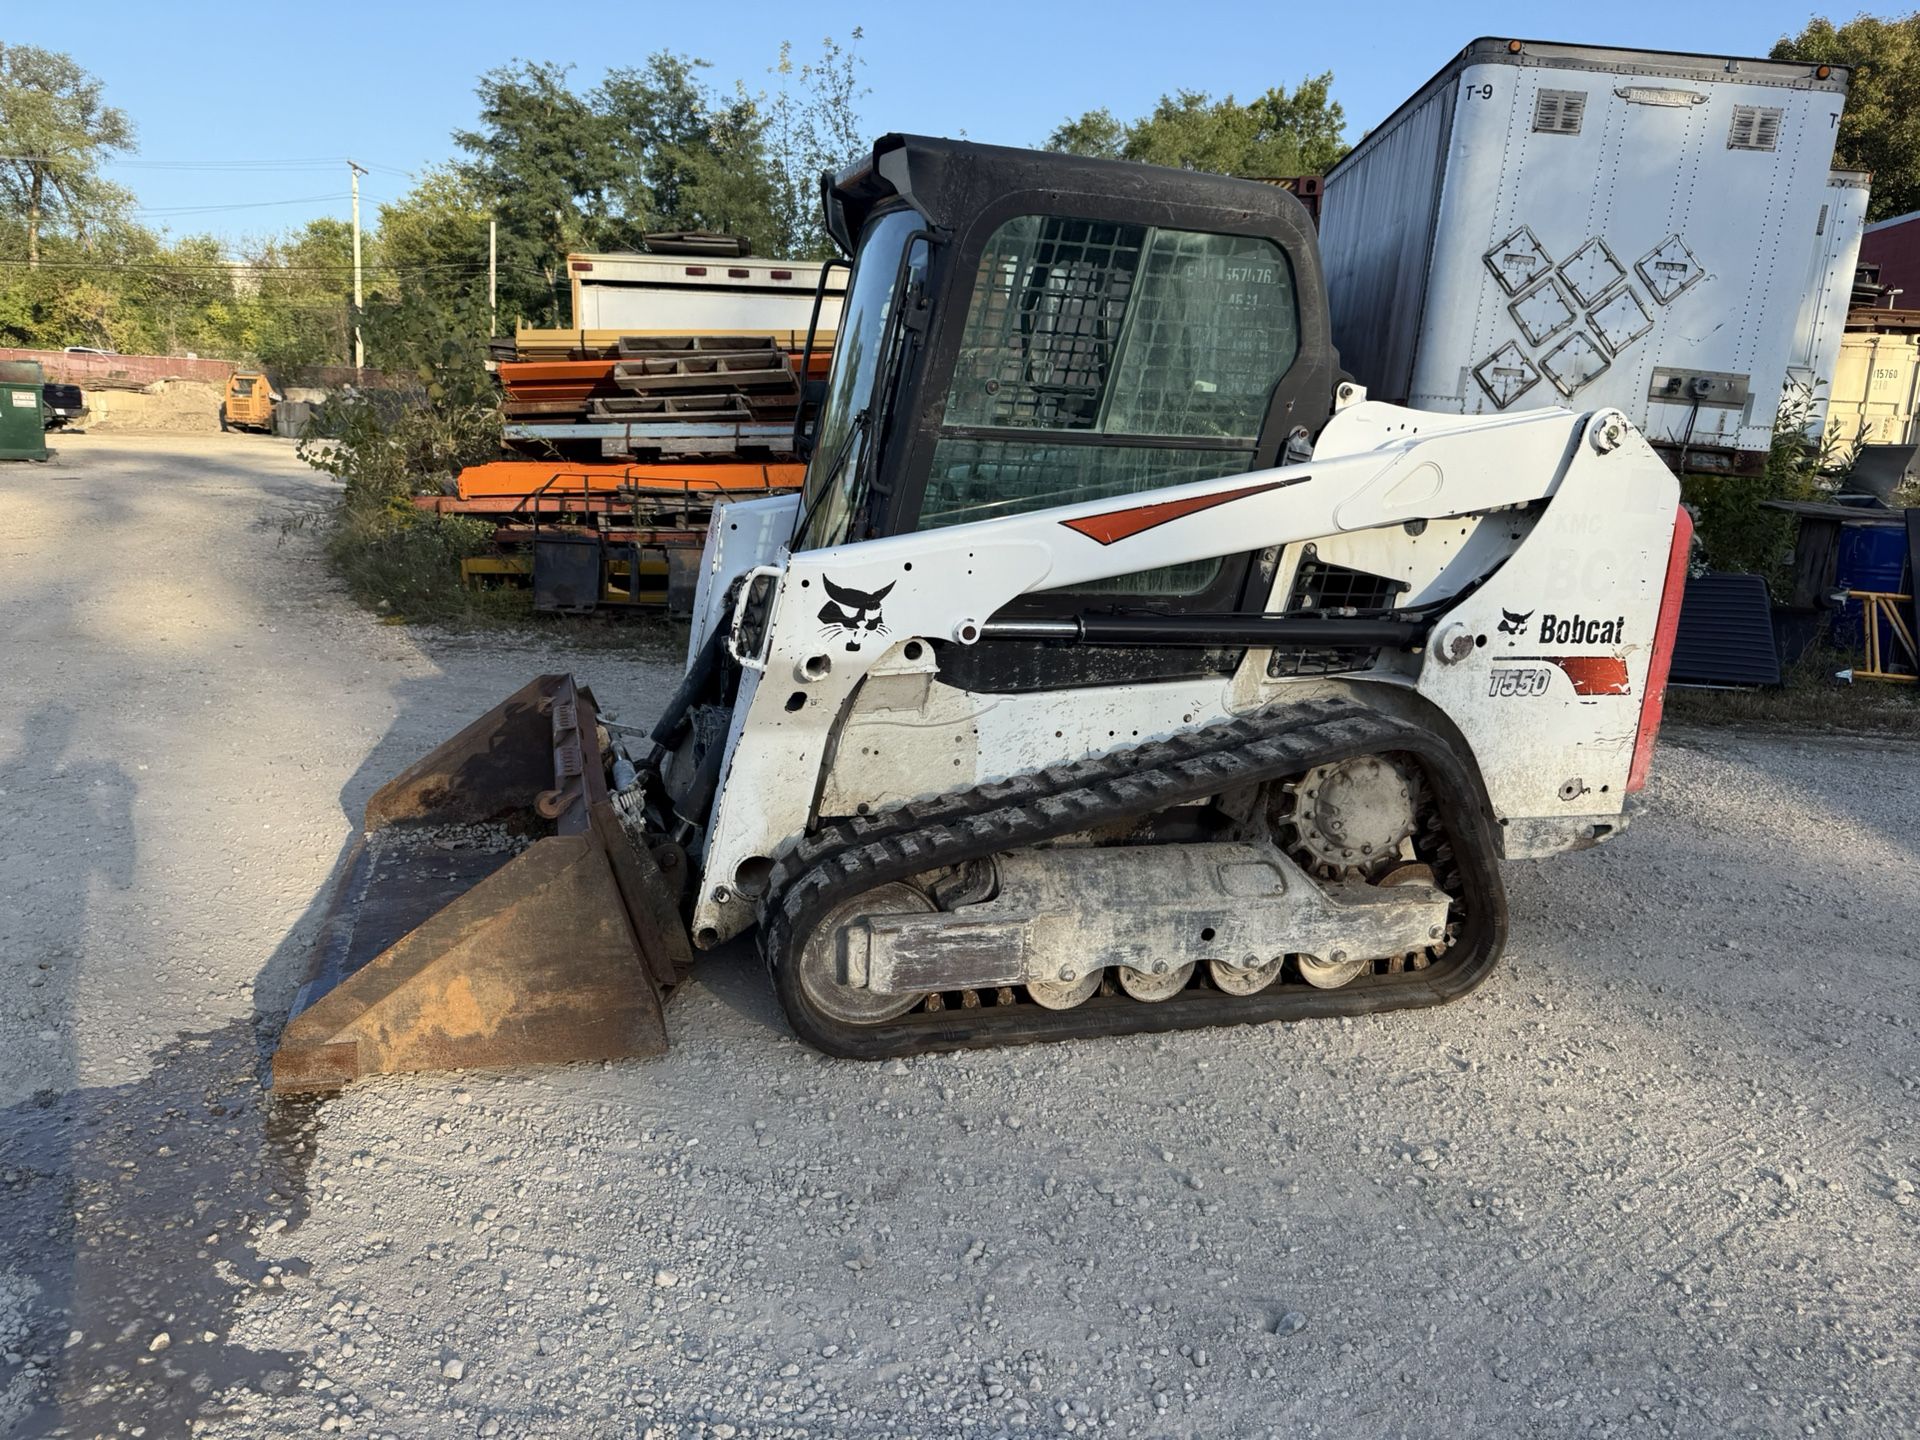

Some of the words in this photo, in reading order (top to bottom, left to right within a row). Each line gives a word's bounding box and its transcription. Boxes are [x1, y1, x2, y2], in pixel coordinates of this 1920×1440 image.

[1466, 84, 1493, 100] T-9
[1539, 614, 1625, 644] Bobcat
[1489, 668, 1552, 697] T550
